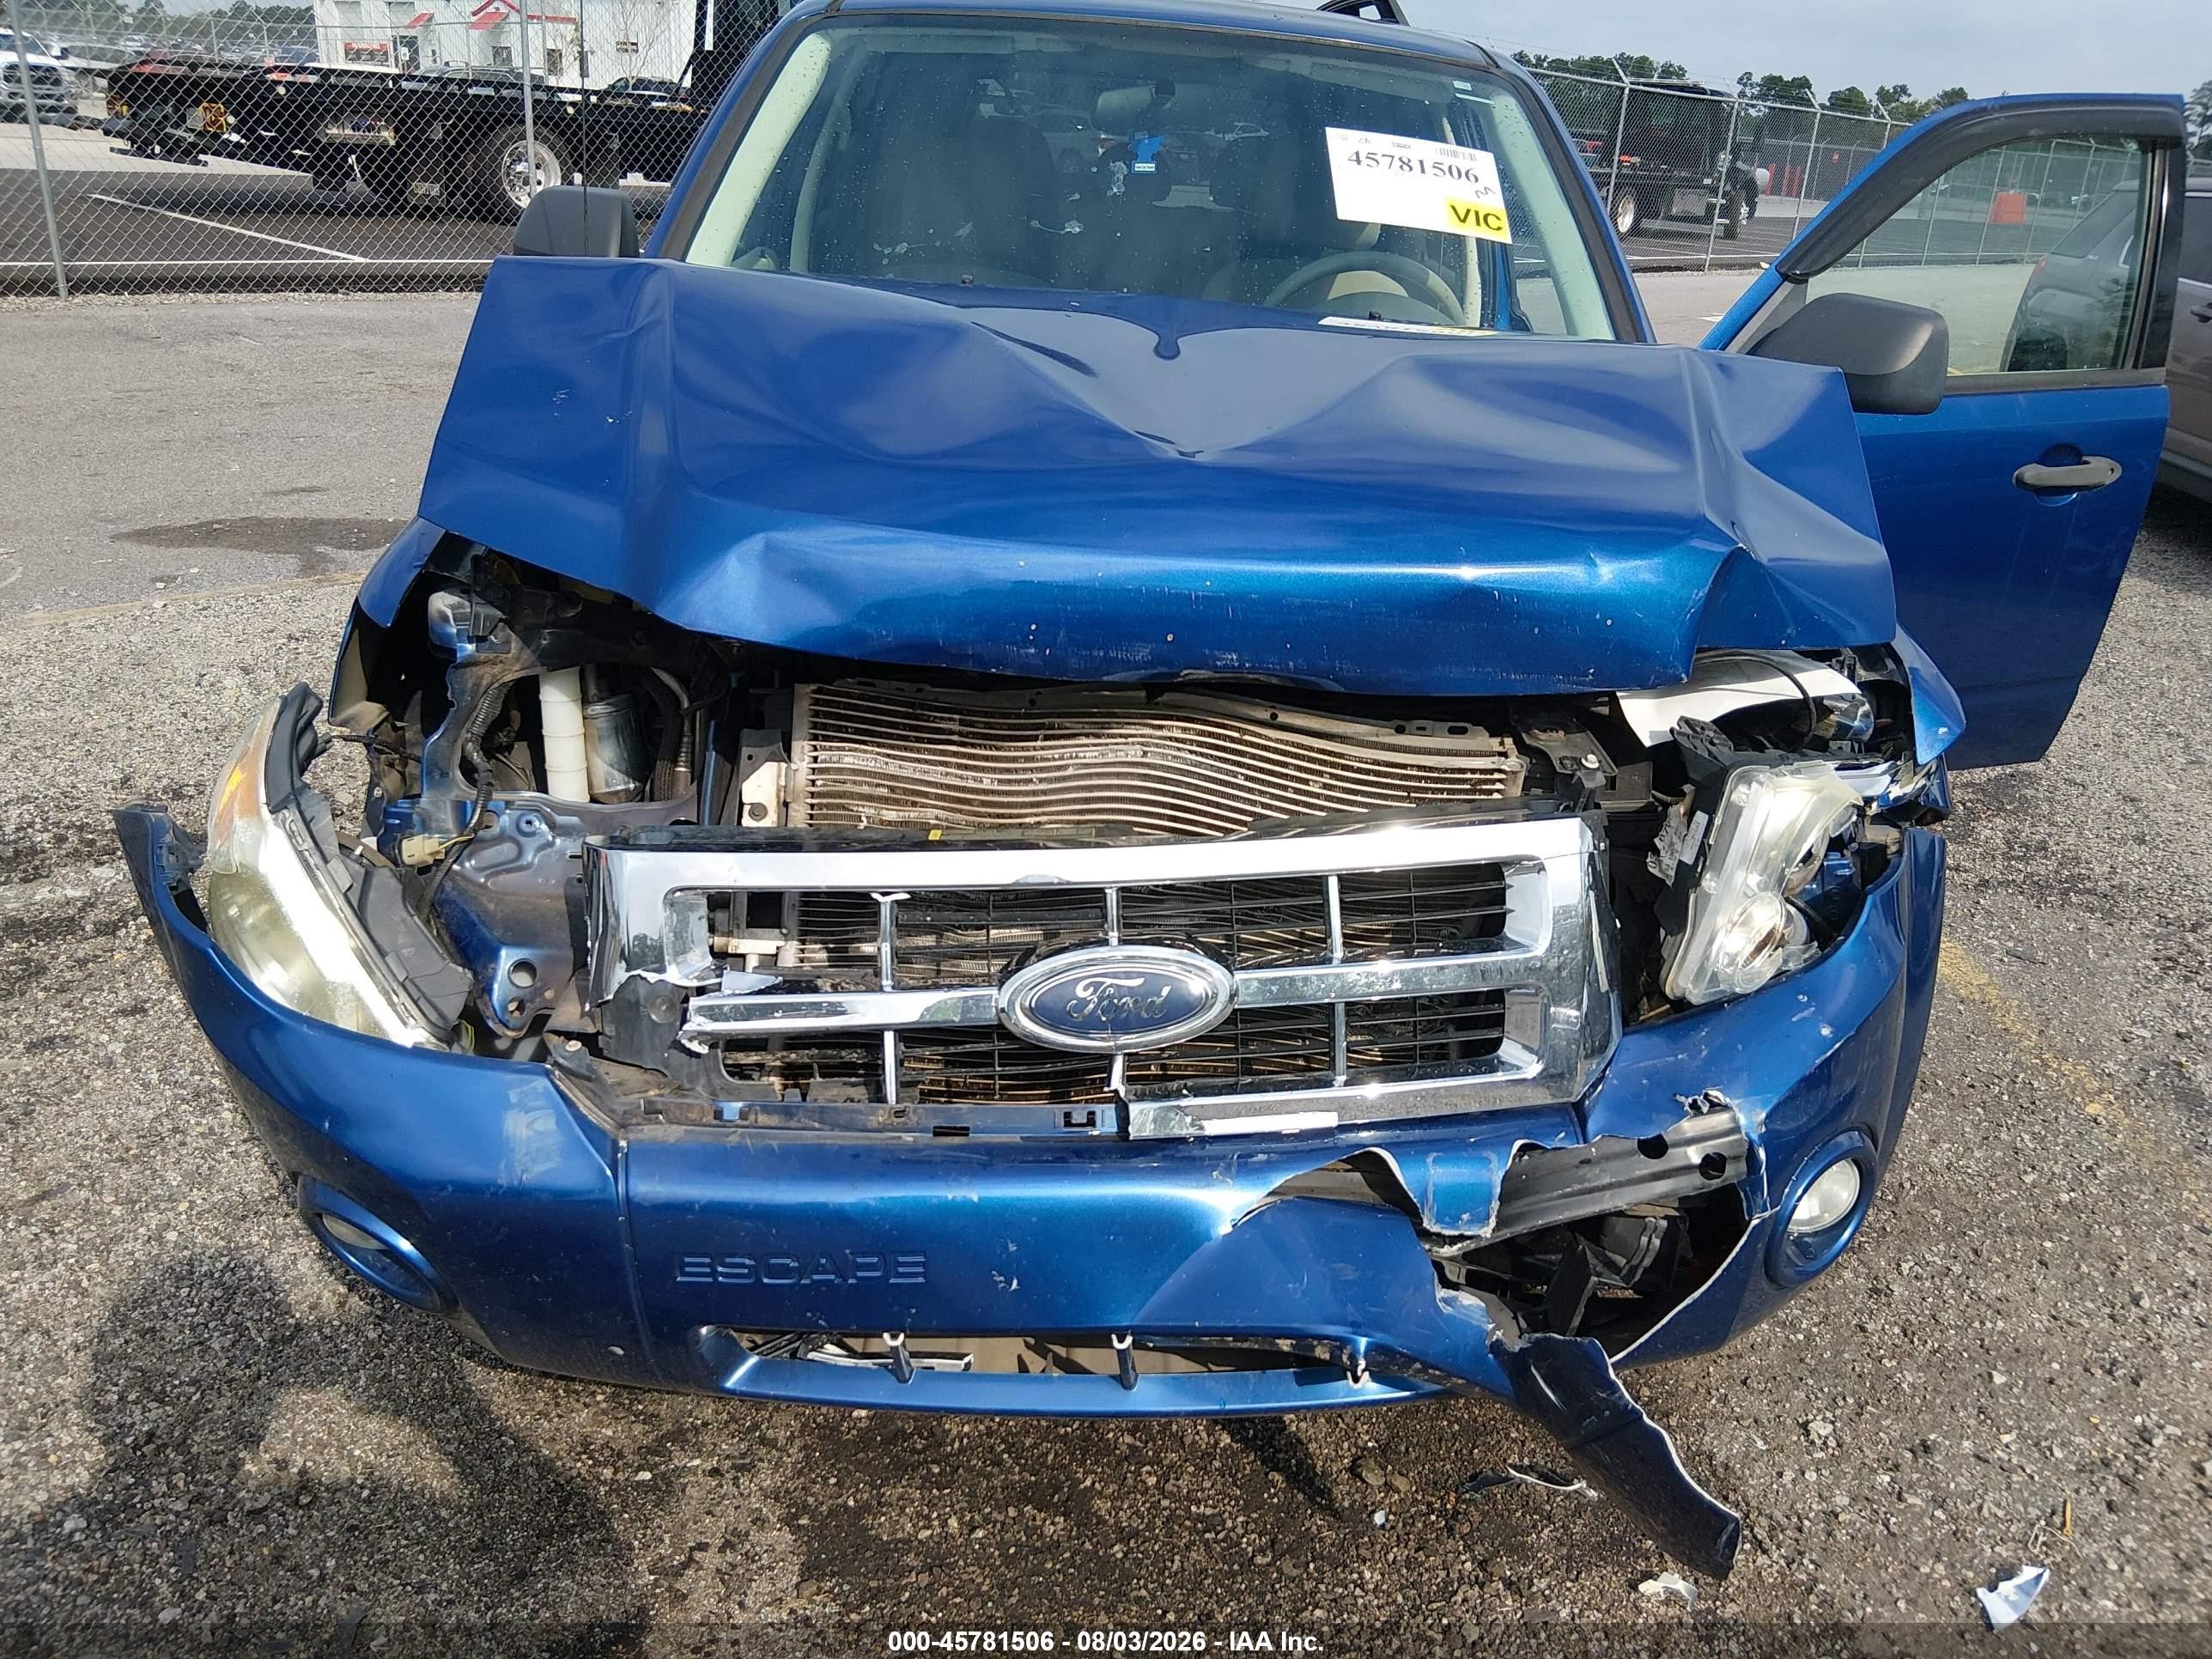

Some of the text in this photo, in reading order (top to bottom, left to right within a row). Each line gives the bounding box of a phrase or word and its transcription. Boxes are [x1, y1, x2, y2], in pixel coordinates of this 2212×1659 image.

[1347, 149, 1480, 185] 45781506
[1449, 204, 1504, 232] VIC
[1066, 976, 1172, 1022] Ford
[675, 1251, 927, 1285] ESCAPE
